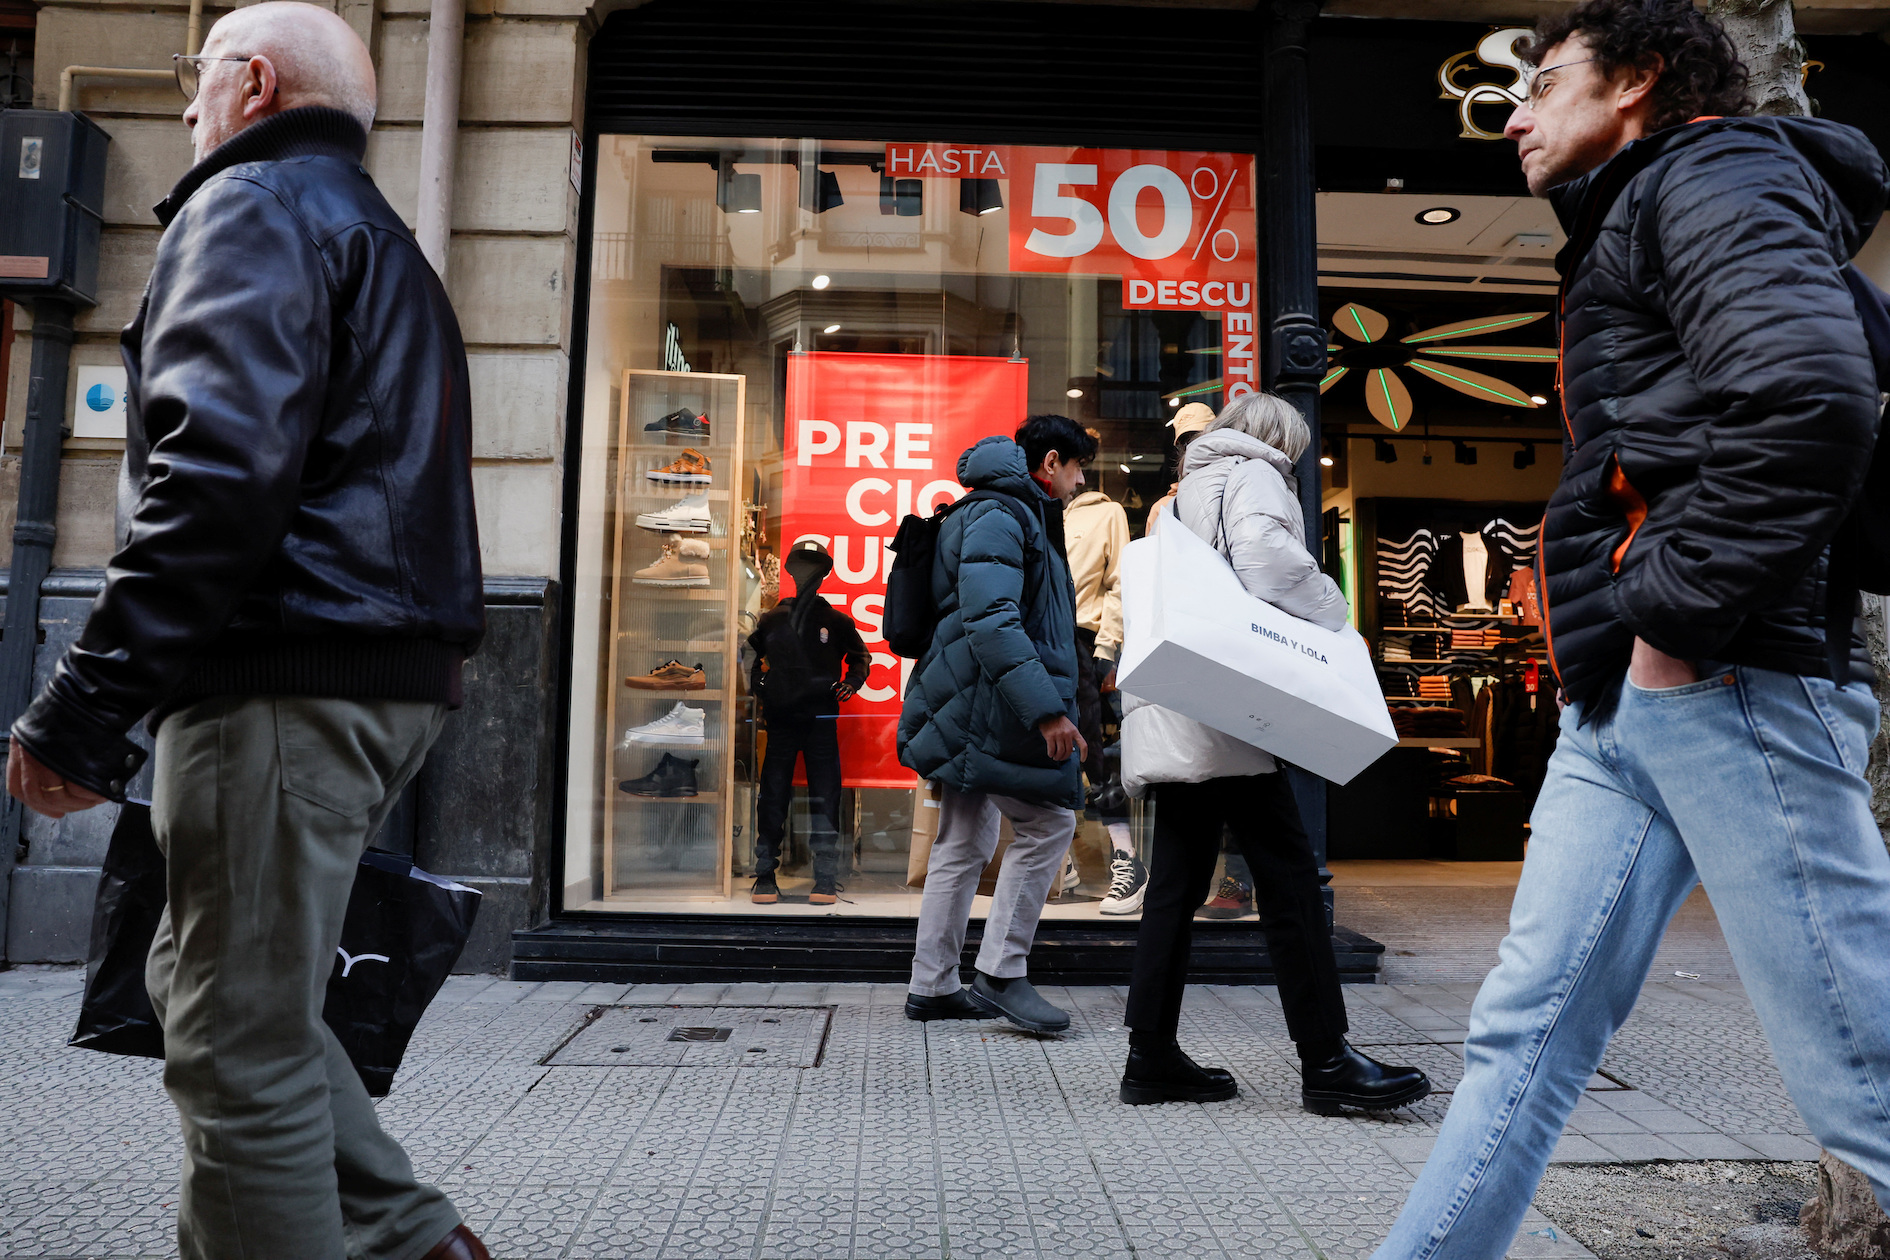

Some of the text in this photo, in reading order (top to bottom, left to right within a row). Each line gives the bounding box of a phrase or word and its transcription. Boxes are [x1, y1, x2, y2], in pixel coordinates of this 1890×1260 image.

[890, 148, 1006, 175] HASTA
[1024, 163, 1239, 262] 50%
[1128, 279, 1251, 308] DESCU
[797, 419, 933, 469] PRE
[1251, 623, 1328, 665] BIMBA Y LOLA
